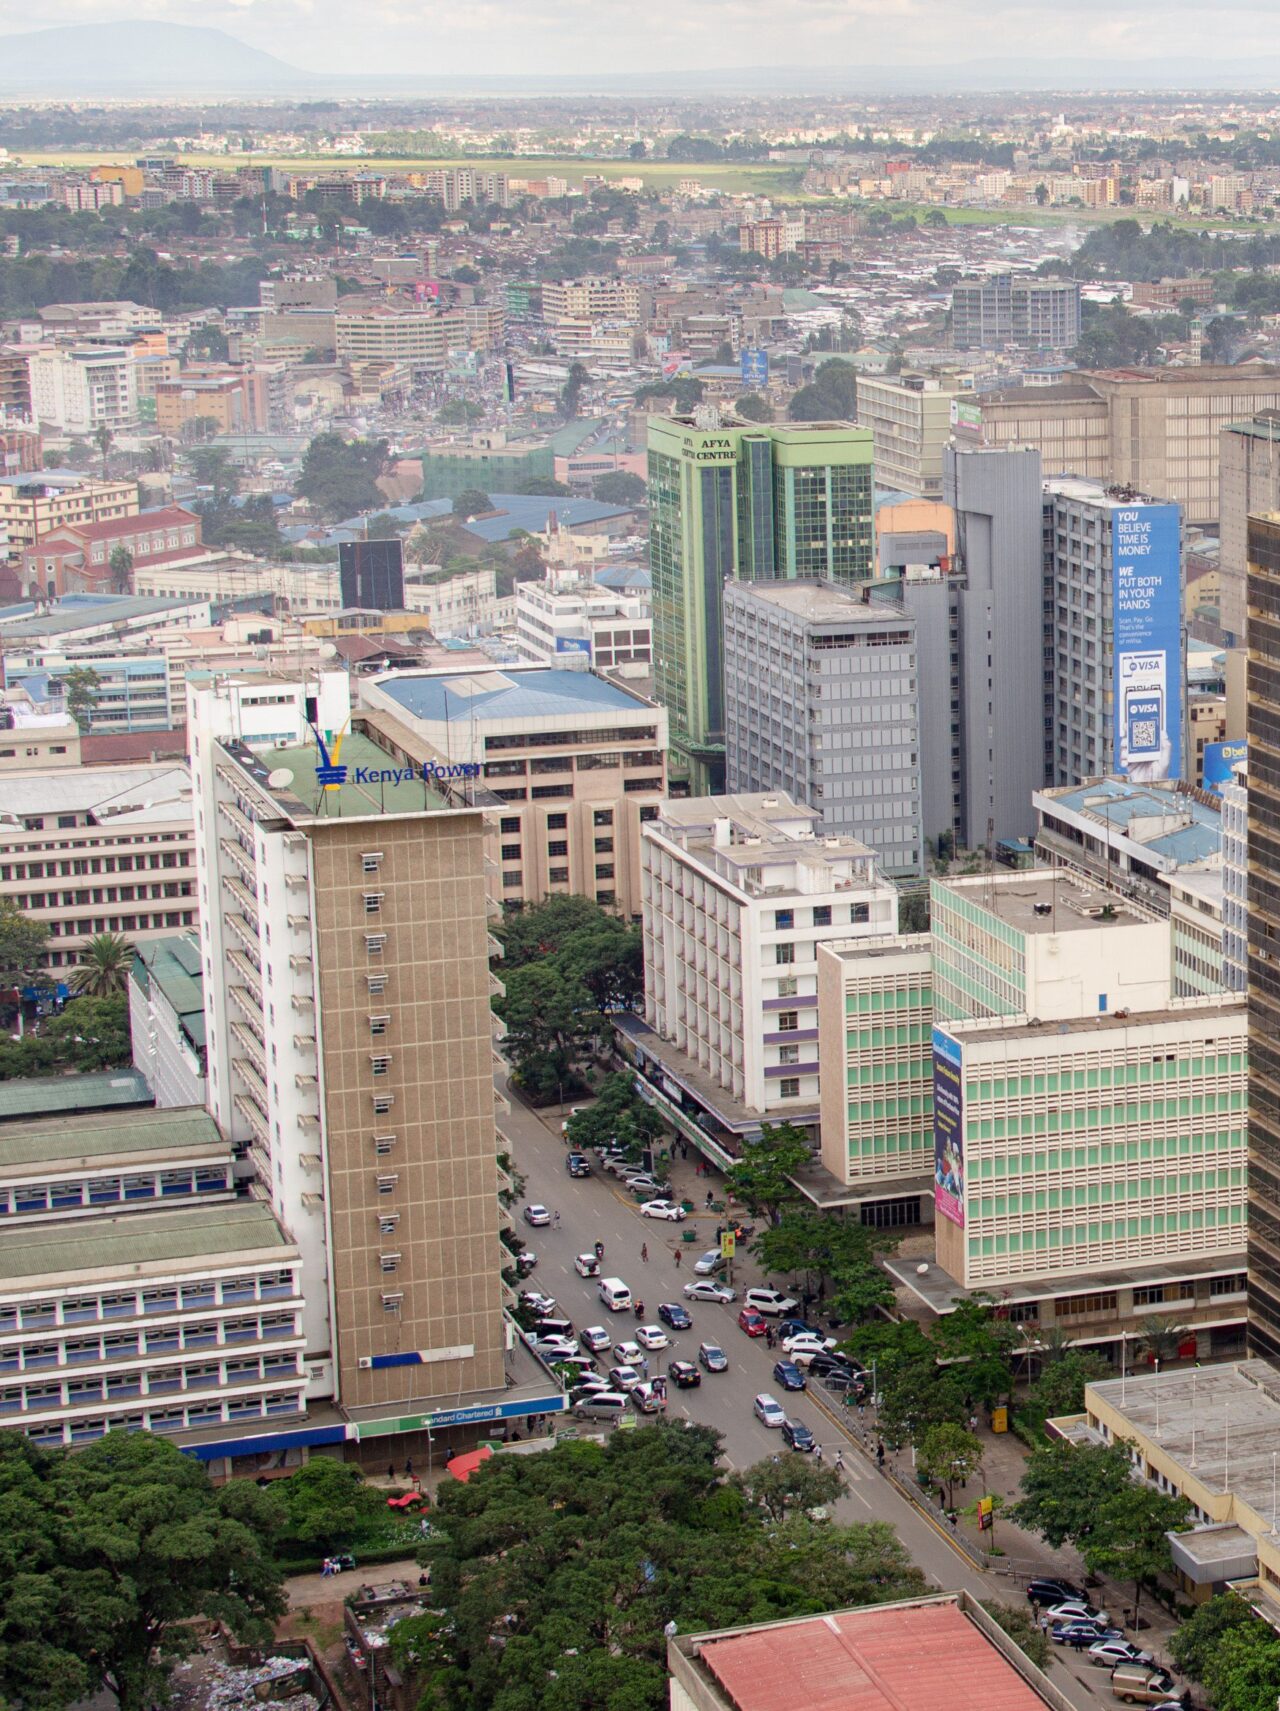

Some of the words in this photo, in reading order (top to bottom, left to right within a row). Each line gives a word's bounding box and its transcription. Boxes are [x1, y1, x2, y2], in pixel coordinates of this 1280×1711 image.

[701, 439, 731, 448] AFYA
[696, 451, 737, 460] CENTRE
[1118, 512, 1138, 521] YOU
[1118, 522, 1152, 533] BELIEVE
[1118, 534, 1139, 544] TIME
[1140, 534, 1149, 543] IS
[1118, 545, 1152, 556] MONEY
[1119, 566, 1134, 576] WE
[1119, 577, 1136, 588] PUT
[1137, 576, 1162, 586] BOTH
[1119, 589, 1128, 599] IN
[1130, 587, 1155, 598] YOUR
[1119, 599, 1151, 610] HANDS
[1138, 661, 1160, 671] VISA
[1138, 703, 1158, 713] VISA
[355, 767, 414, 787] Kenya
[423, 762, 481, 780] Power
[456, 1408, 493, 1420] Chartered
